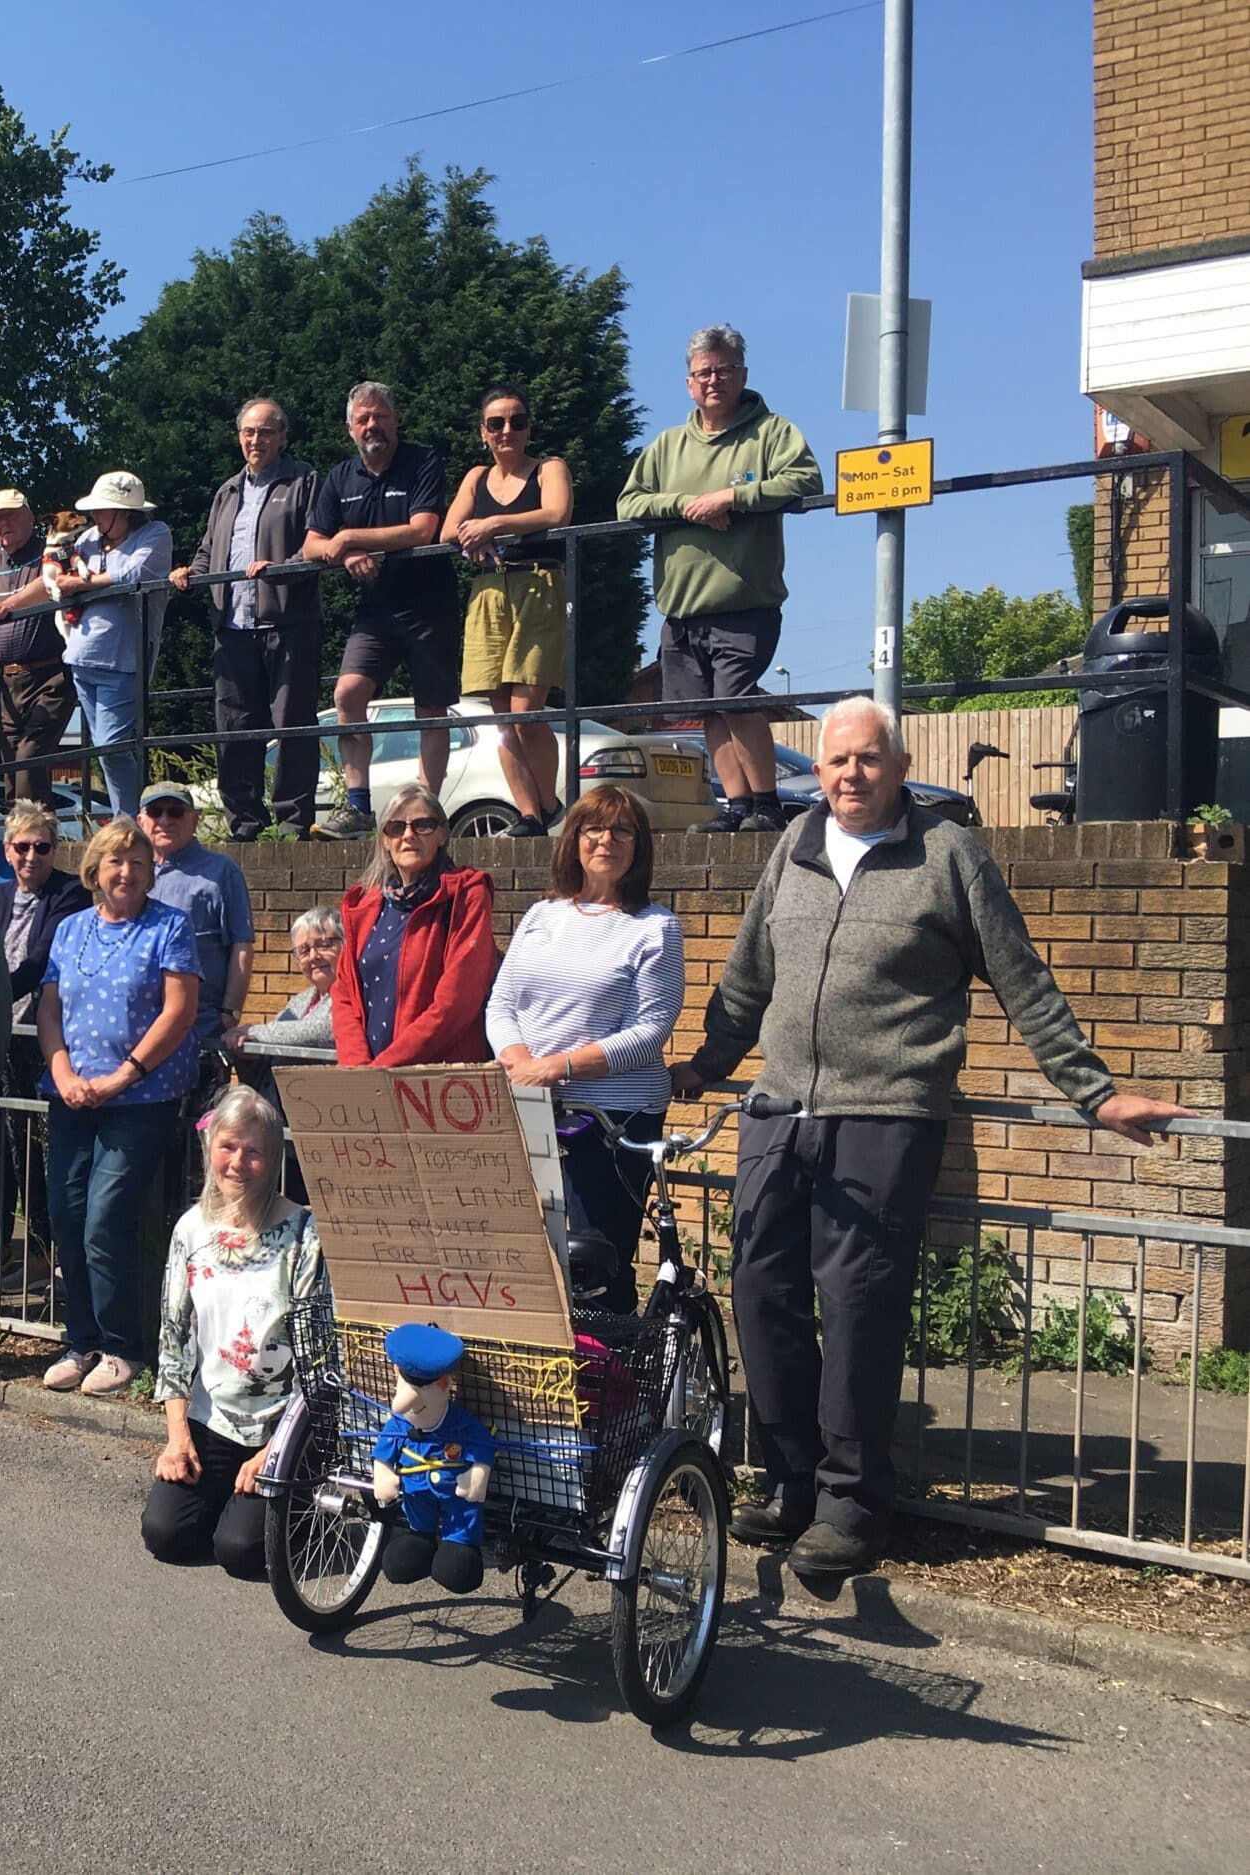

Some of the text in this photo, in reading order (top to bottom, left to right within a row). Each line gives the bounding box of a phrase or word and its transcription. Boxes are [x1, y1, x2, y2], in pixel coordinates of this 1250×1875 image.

[853, 471, 878, 482] Mon
[893, 465, 915, 477] Sat
[285, 1078, 380, 1134] Say
[300, 1139, 323, 1164] to
[331, 1135, 397, 1169] HS2
[317, 1176, 534, 1213] PIREHILL LANE
[330, 1215, 494, 1239] AS A ROUTE
[372, 1241, 526, 1270] FOR THEIR
